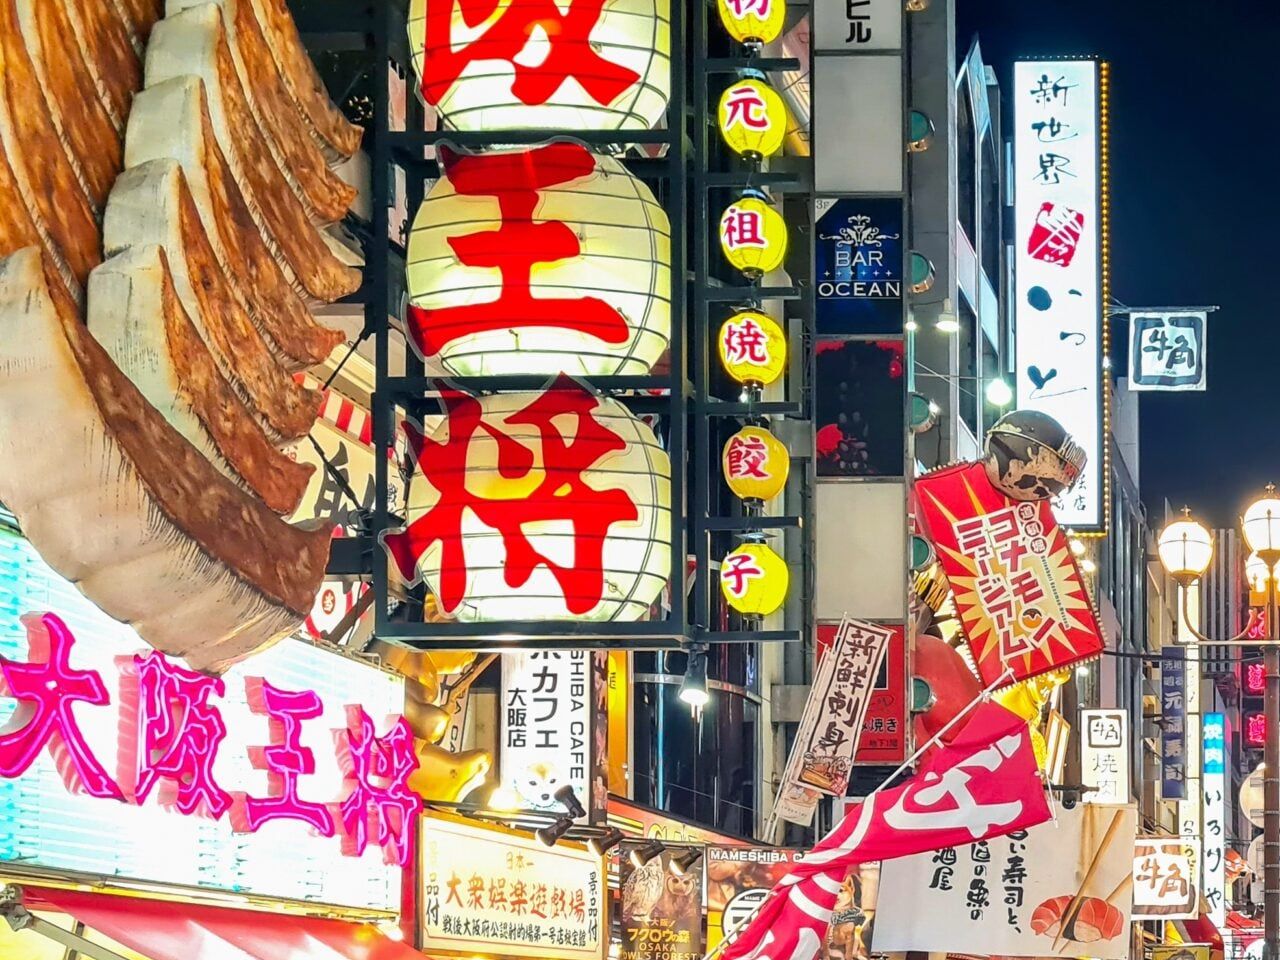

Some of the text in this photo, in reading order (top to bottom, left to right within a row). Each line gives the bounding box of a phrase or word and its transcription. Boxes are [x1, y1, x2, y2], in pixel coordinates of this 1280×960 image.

[1030, 74, 1079, 186] 新世界
[836, 251, 883, 267] BAR
[819, 282, 901, 297] OCEAN
[1143, 329, 1196, 371] 牛角
[818, 629, 877, 754] 新鮮刺身
[507, 687, 527, 748] 大阪店
[0, 612, 423, 867] 大阪王将
[571, 721, 584, 779] CAFE
[710, 850, 788, 862] MAMESHIBA
[1205, 790, 1222, 909] いろりや
[1136, 858, 1188, 899] 牛角
[640, 943, 676, 952] OSAKA
[655, 952, 697, 960] FOREST
